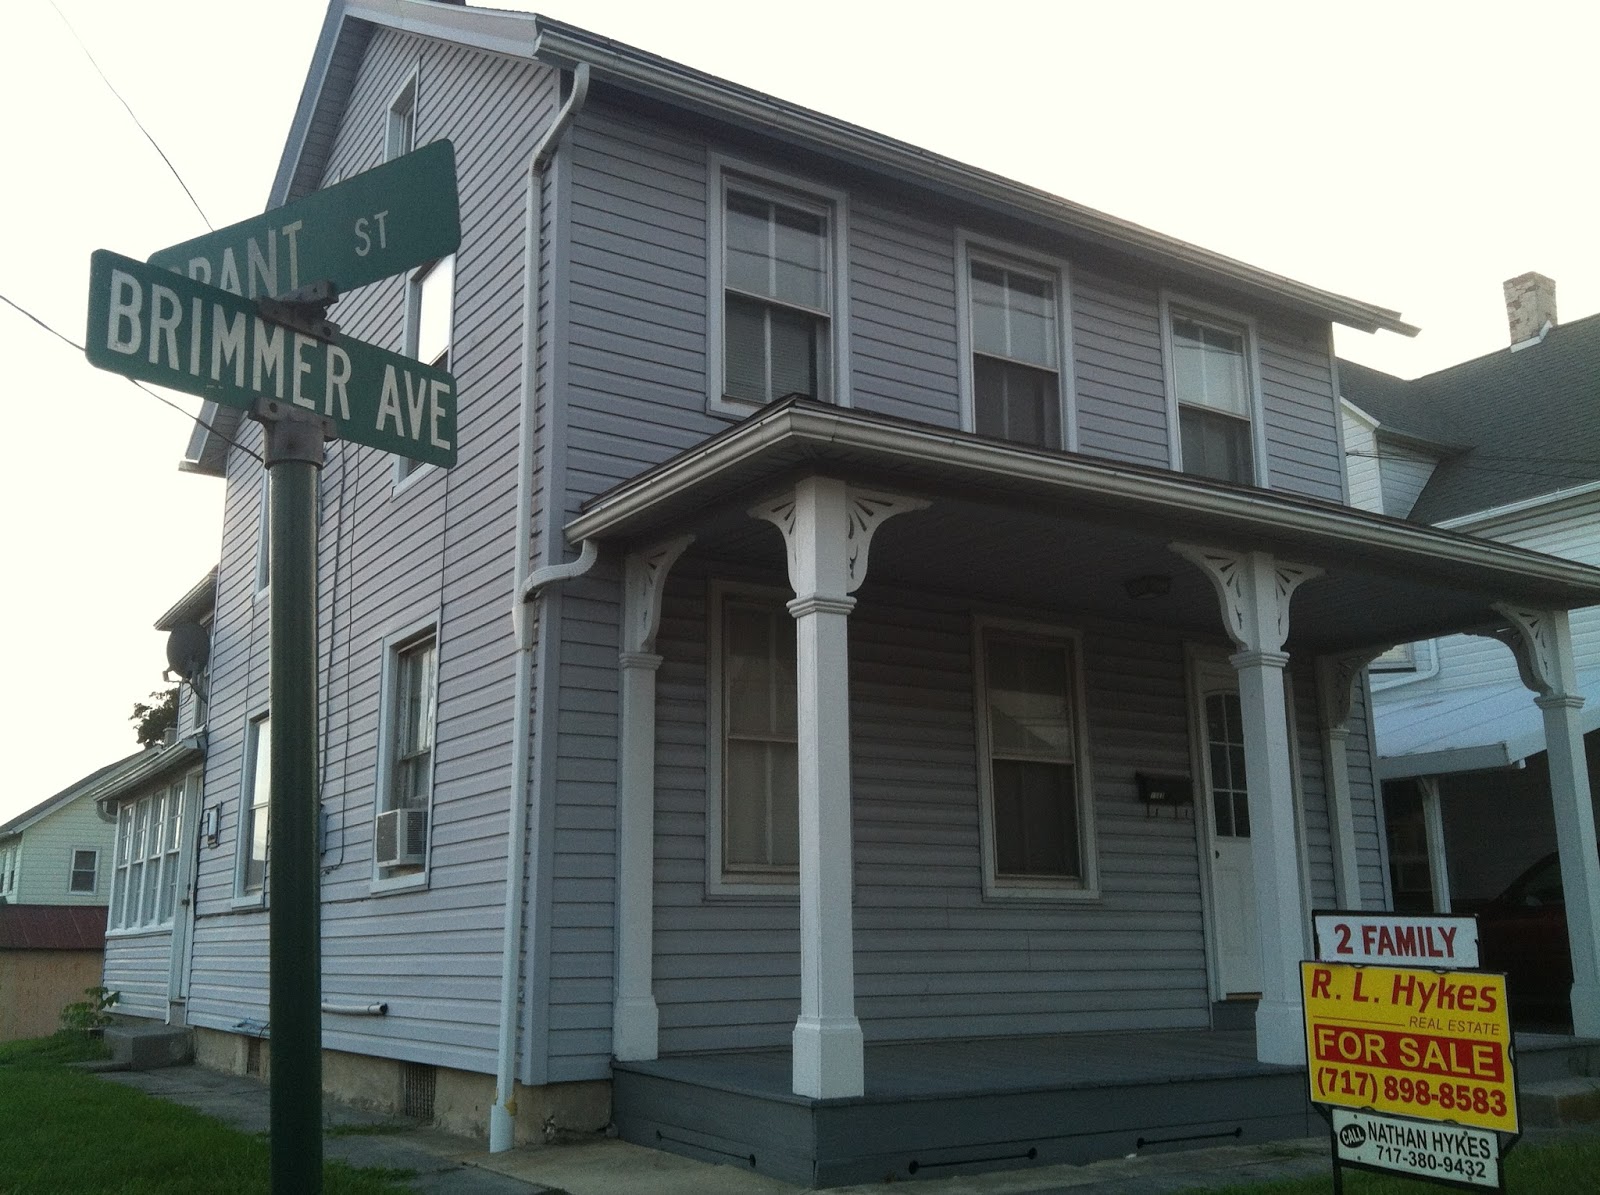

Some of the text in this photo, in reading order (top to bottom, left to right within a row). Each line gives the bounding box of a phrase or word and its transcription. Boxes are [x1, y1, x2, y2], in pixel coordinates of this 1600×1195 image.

[355, 210, 389, 257] ST
[107, 268, 451, 450] BRIMMER AVE
[1334, 923, 1457, 958] 2 FAMILY
[1311, 968, 1497, 1013] R. L. Hykes
[1409, 1015, 1500, 1035] REAL ESTATE
[1318, 1028, 1496, 1077] FOR SALE
[1317, 1066, 1508, 1117] (717) 898-8583
[1341, 1121, 1491, 1160] CALL NATHAN HYKES
[1376, 1144, 1487, 1179] 717-380-9432
